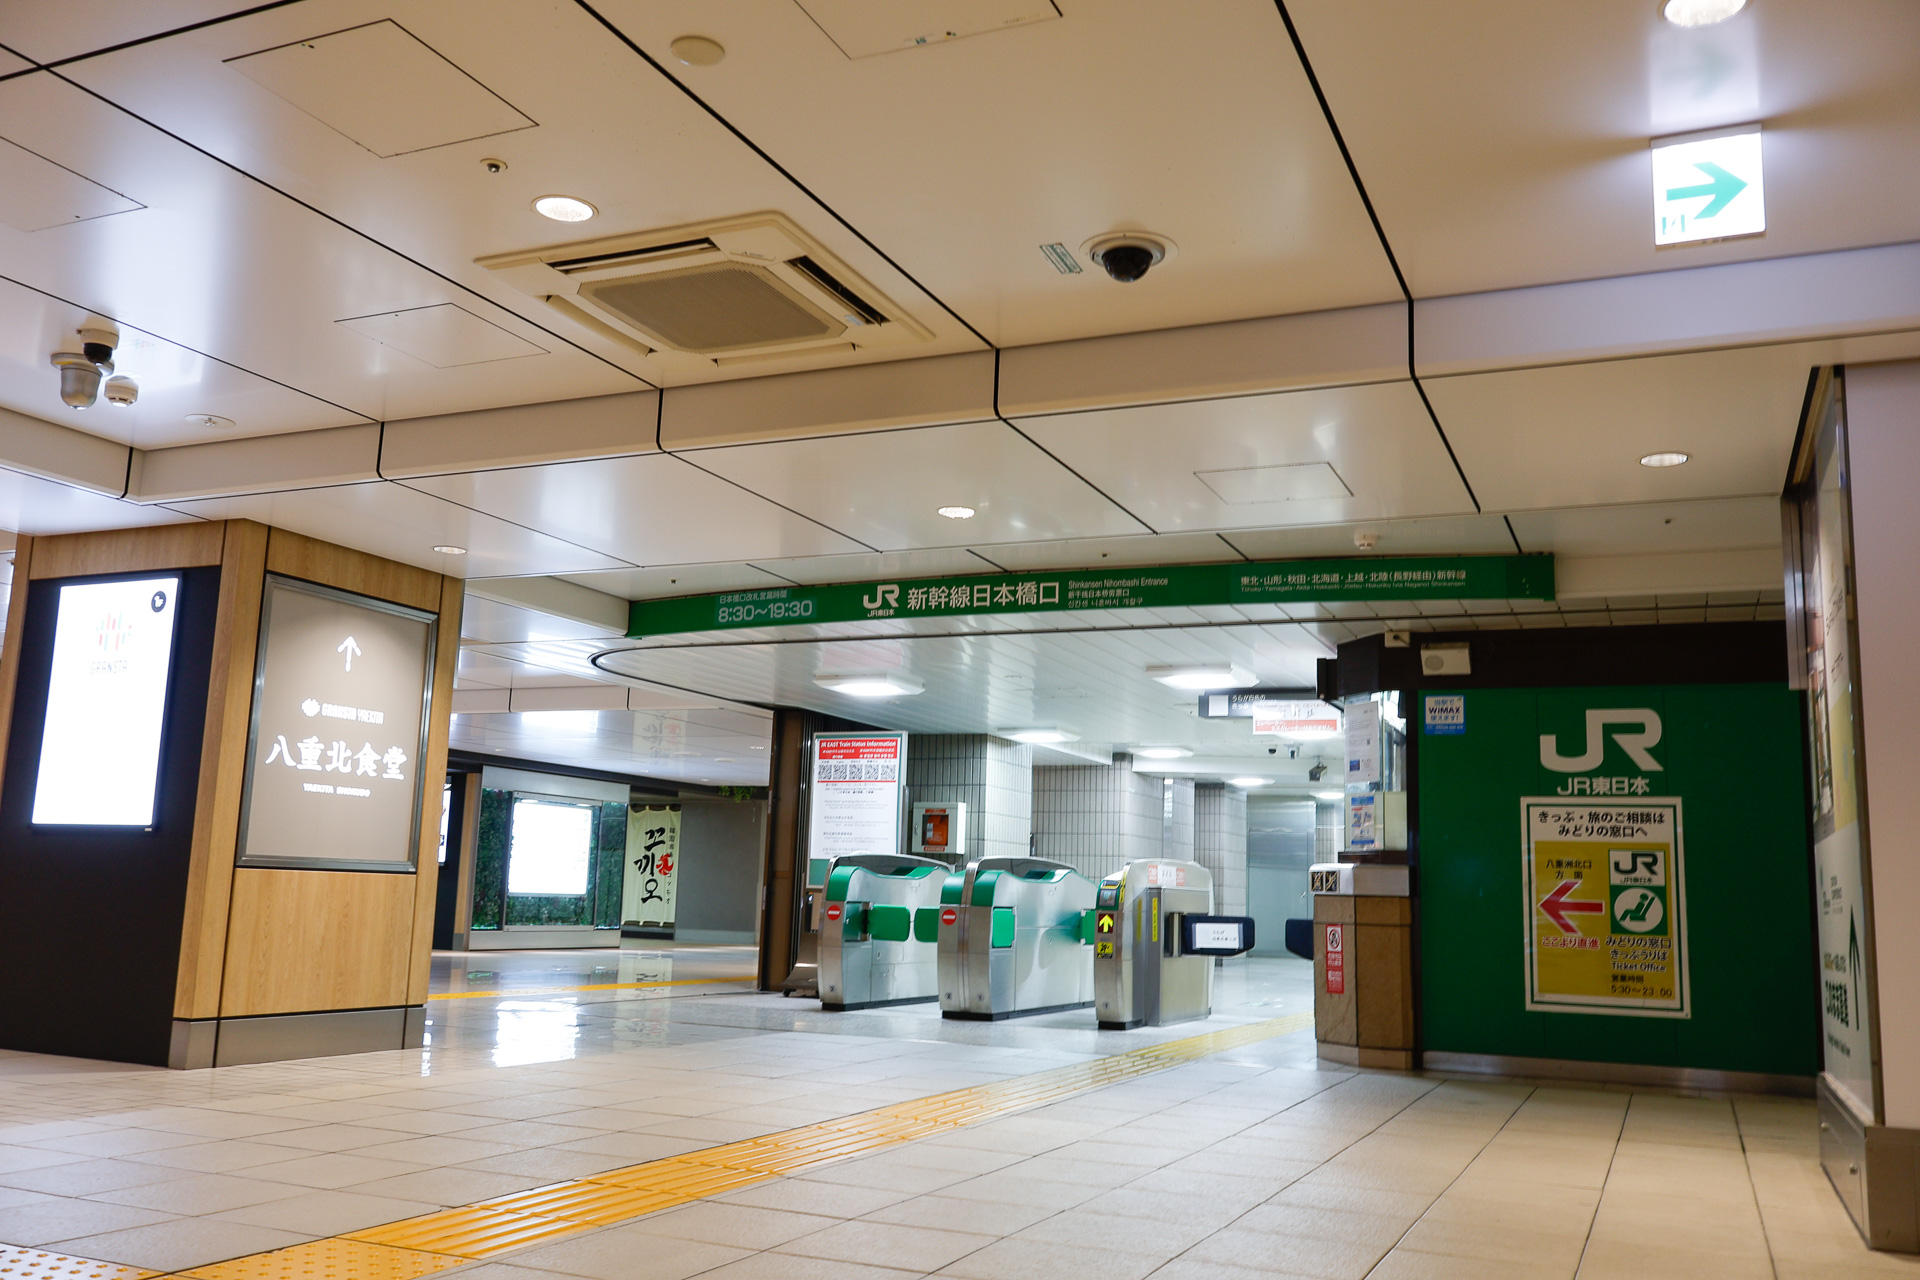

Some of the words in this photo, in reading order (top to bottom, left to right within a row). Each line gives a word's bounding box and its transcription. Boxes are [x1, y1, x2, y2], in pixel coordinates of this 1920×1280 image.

[1068, 579, 1102, 589] Shinkansen
[1140, 576, 1168, 587] Entrance
[863, 584, 900, 609] JR
[907, 581, 1059, 610] 新幹線日本橋口
[718, 600, 812, 622] 8:30～19:30
[867, 608, 895, 618] JR東日本
[90, 660, 128, 675] GRANSTA
[1429, 706, 1460, 714] WiMAX
[867, 739, 896, 747] Information
[1540, 707, 1664, 773] JR
[264, 734, 408, 780] 八重北食堂
[1557, 776, 1650, 796] JR東日本
[1538, 810, 1665, 825] きっぷ・旅のご相談は
[1558, 824, 1648, 838] みどりの窓口へ
[633, 827, 666, 904] 꼬끼오
[1614, 852, 1659, 876] JR
[1542, 935, 1600, 950] ここより直進
[1605, 935, 1672, 949] みどりの窓口
[1610, 949, 1668, 961] きっぷうりば
[1611, 961, 1638, 971] Ticket
[1640, 962, 1667, 972] Office
[1611, 974, 1644, 984] 営業時間
